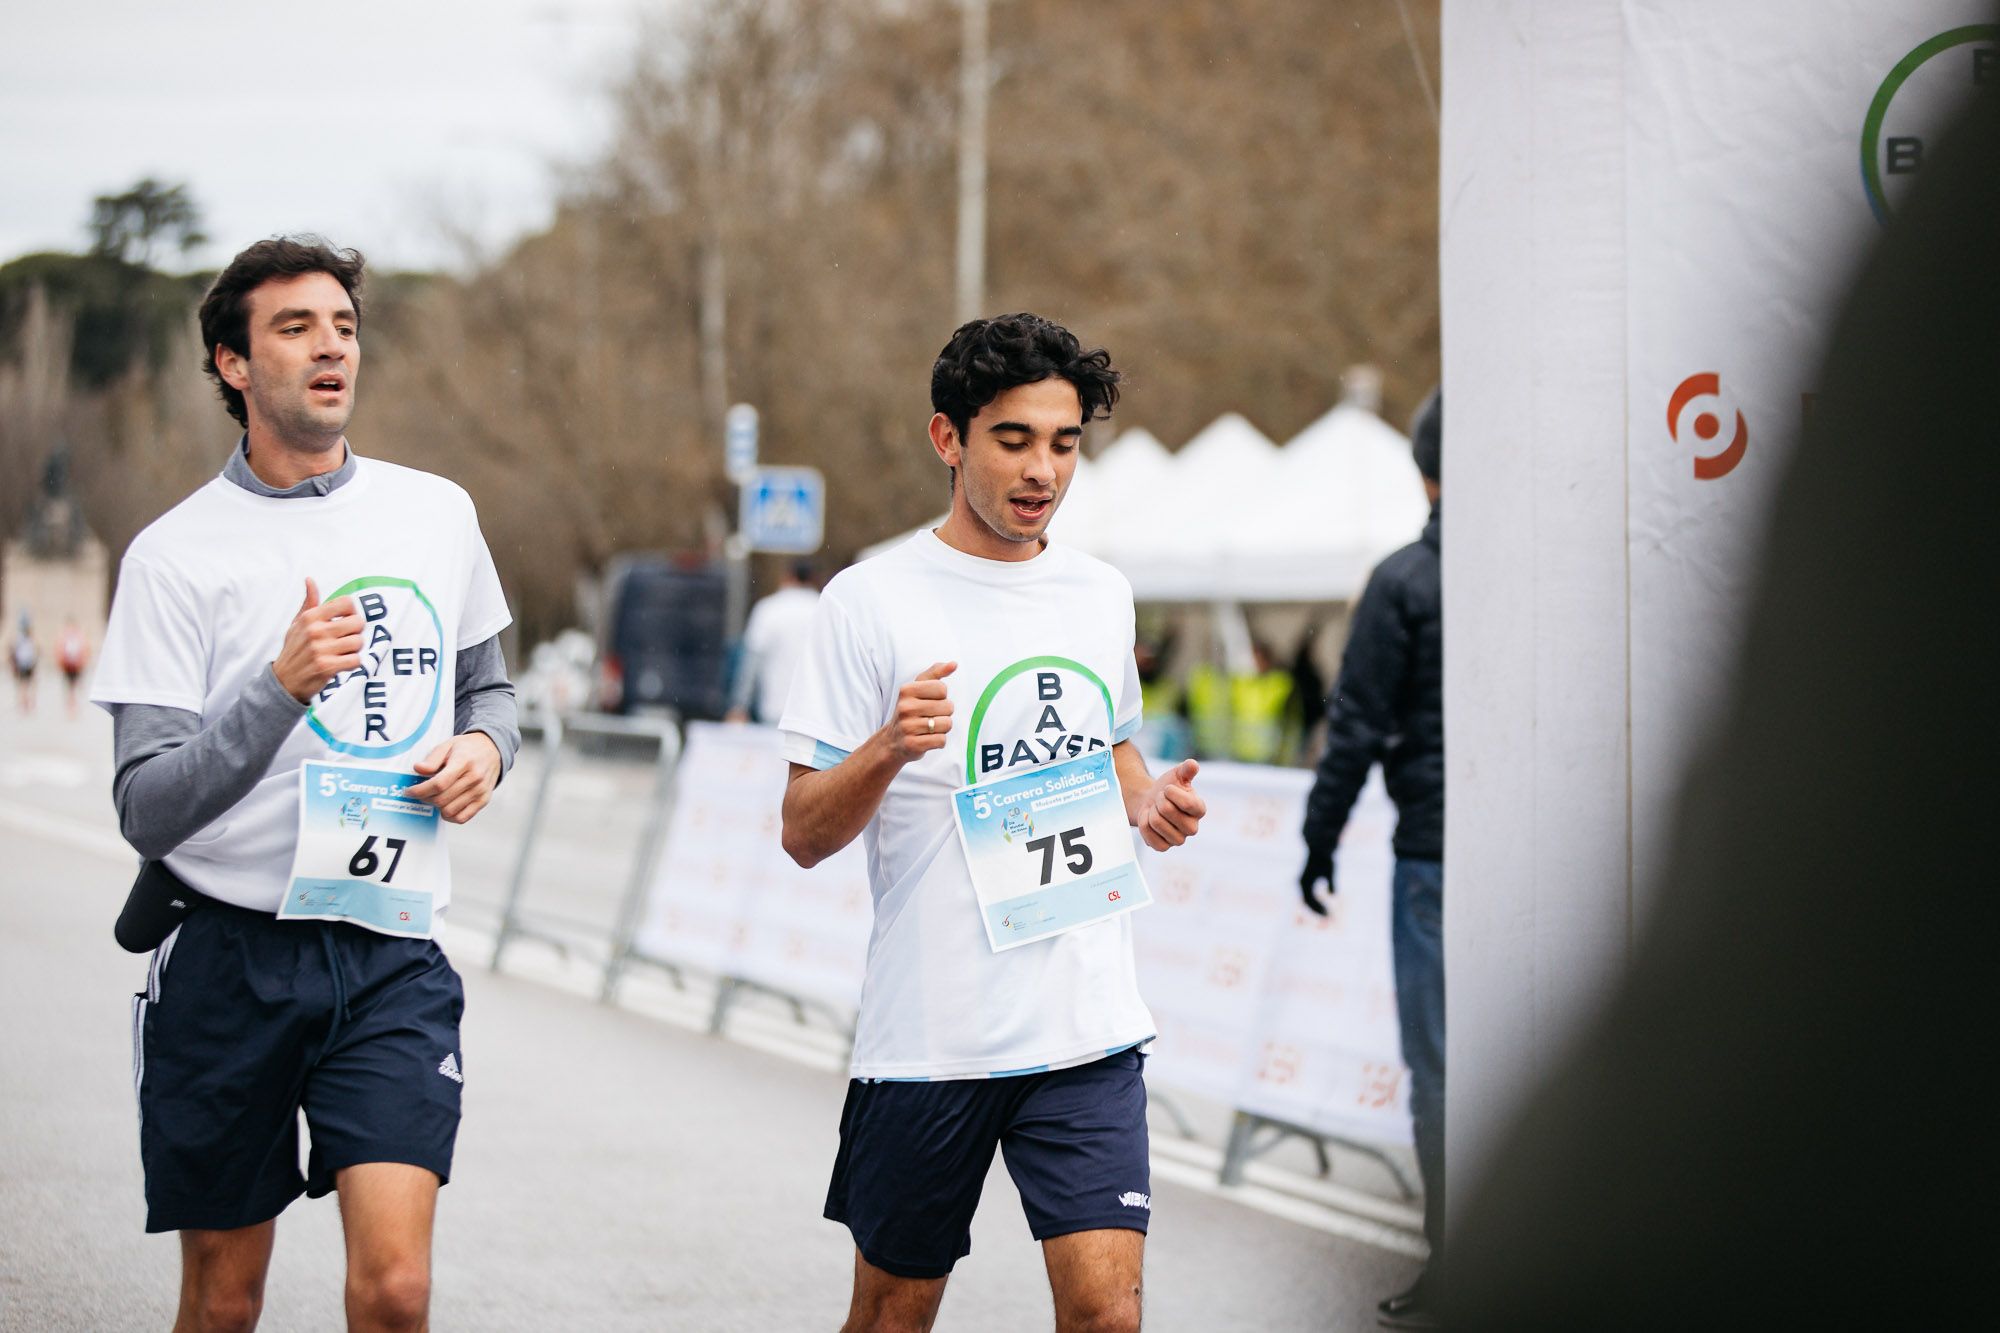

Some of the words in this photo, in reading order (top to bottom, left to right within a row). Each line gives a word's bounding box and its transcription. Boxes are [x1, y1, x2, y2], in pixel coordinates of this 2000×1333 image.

[1035, 672, 1067, 761] BAY
[338, 779, 388, 796] Carrera
[993, 786, 1044, 807] Carrera
[1045, 770, 1095, 792] Solidaria
[348, 834, 407, 884] 67
[1025, 826, 1094, 887] 75
[1108, 890, 1121, 902] CSL
